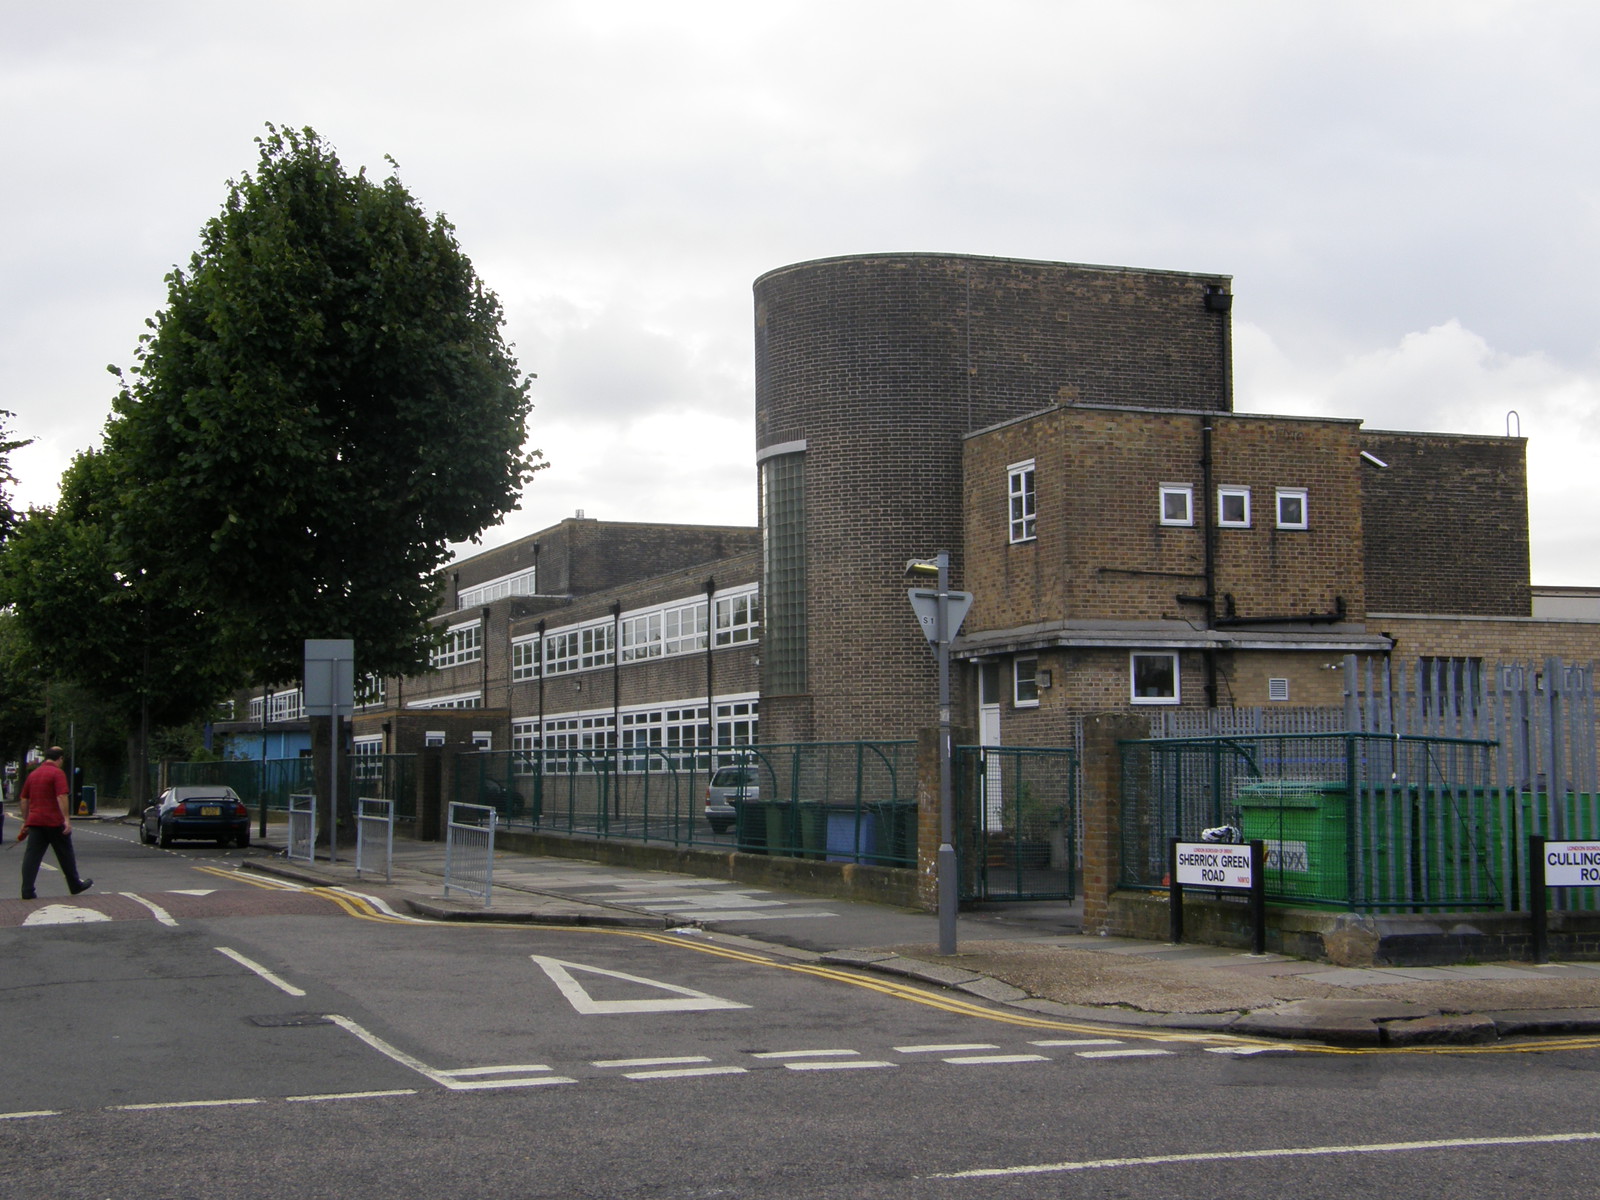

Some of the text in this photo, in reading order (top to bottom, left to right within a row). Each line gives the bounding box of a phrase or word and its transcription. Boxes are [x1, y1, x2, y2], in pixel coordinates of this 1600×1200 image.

[1179, 853, 1250, 869] SHERRICK GREEN
[1201, 868, 1225, 882] ROAD
[1580, 867, 1600, 881] RO
